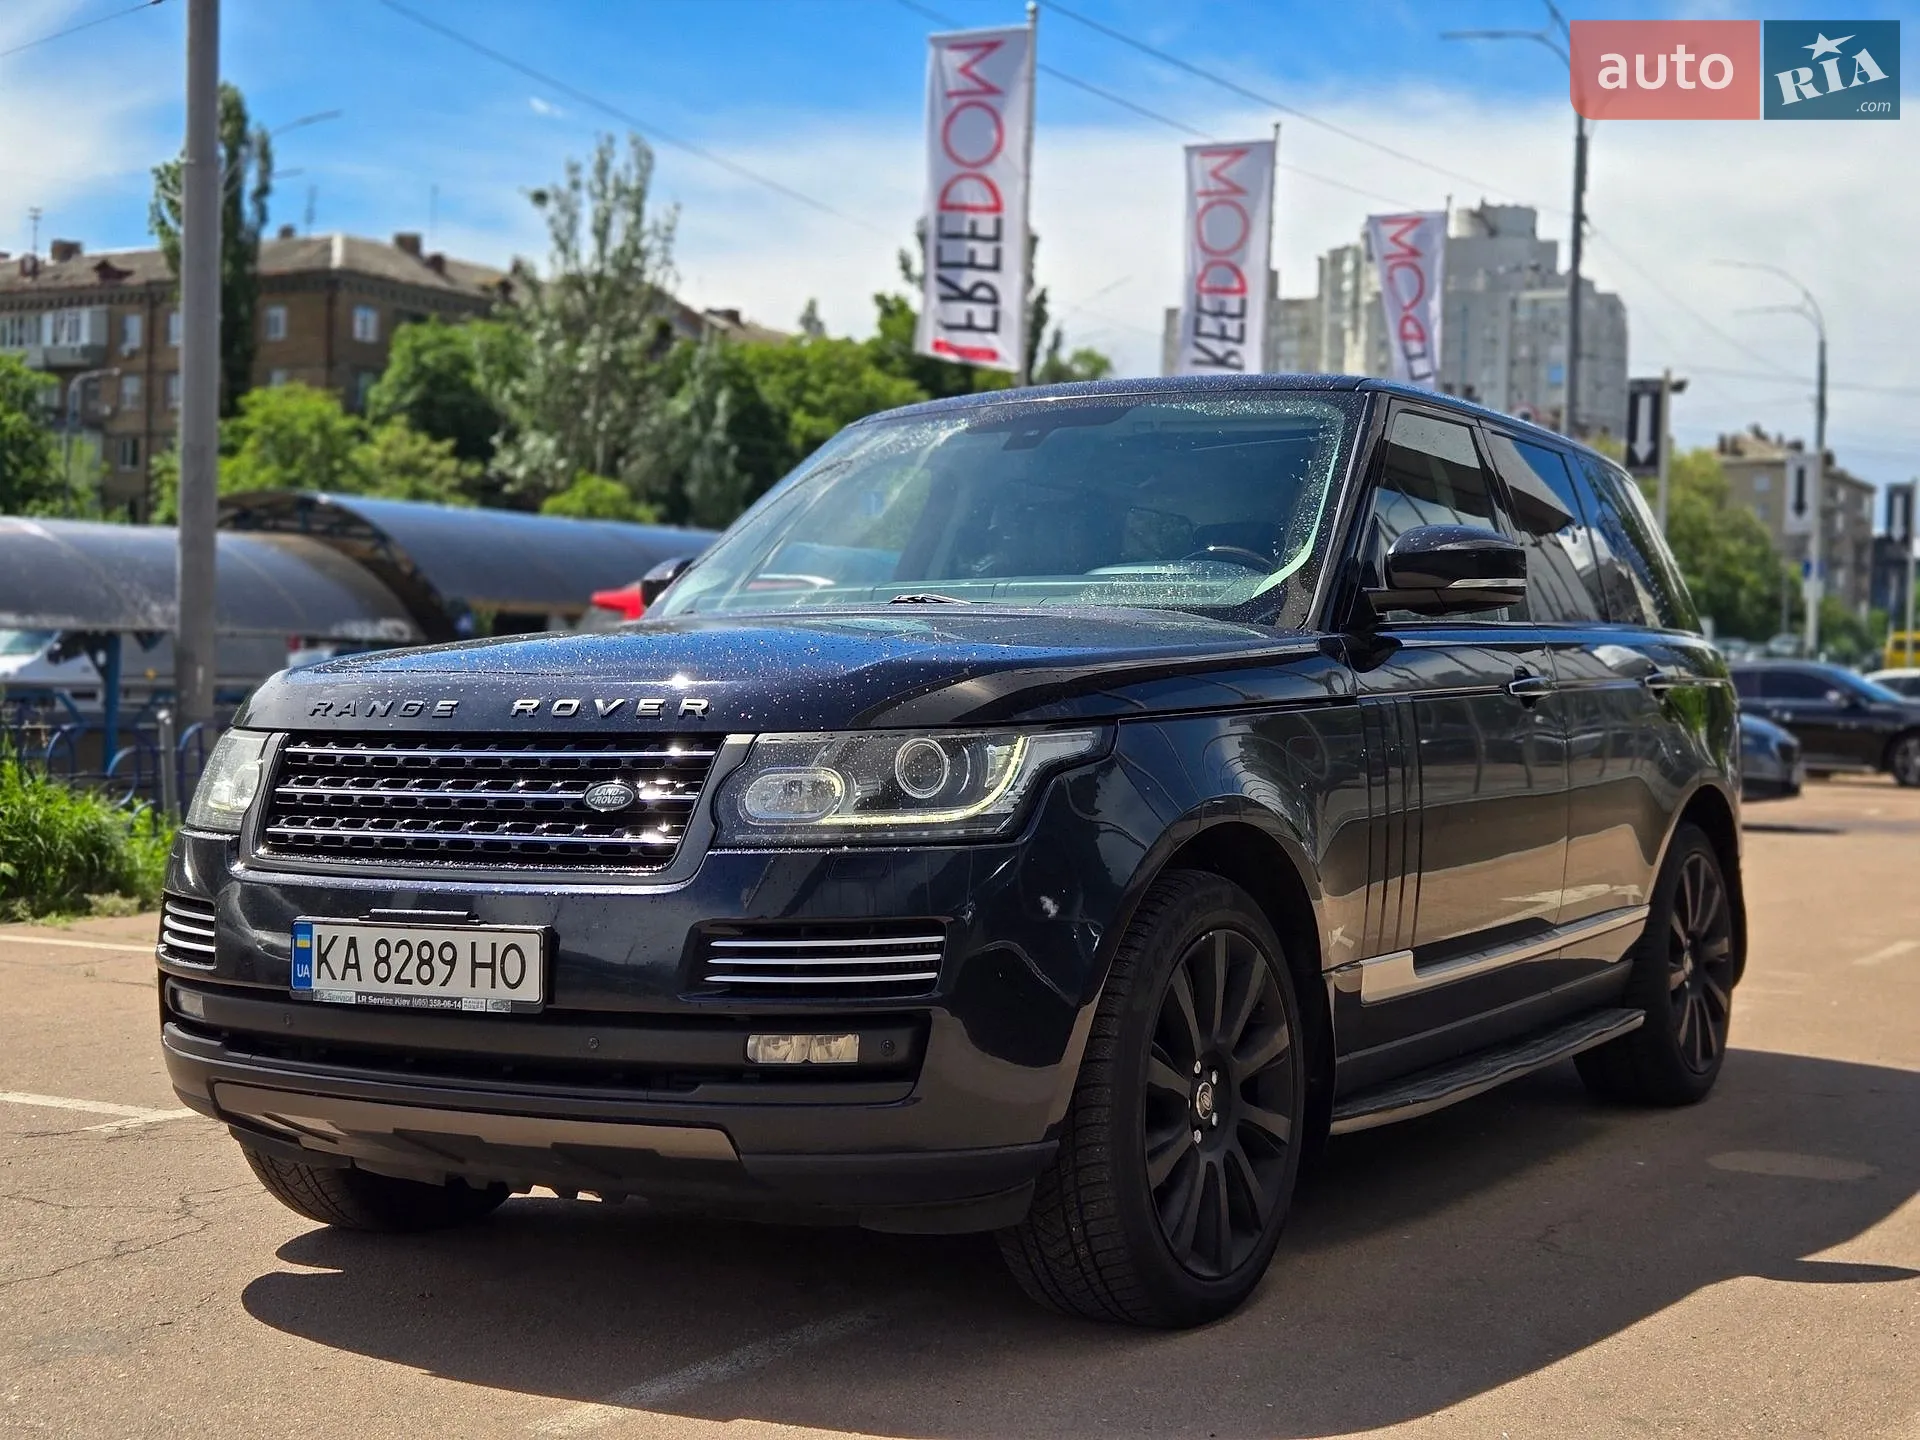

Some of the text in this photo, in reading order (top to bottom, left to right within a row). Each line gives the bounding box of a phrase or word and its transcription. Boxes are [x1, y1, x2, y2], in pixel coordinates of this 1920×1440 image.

[307, 698, 710, 719] RANGE ROVER
[296, 963, 311, 979] UA
[316, 934, 526, 990] KA 8289 HO
